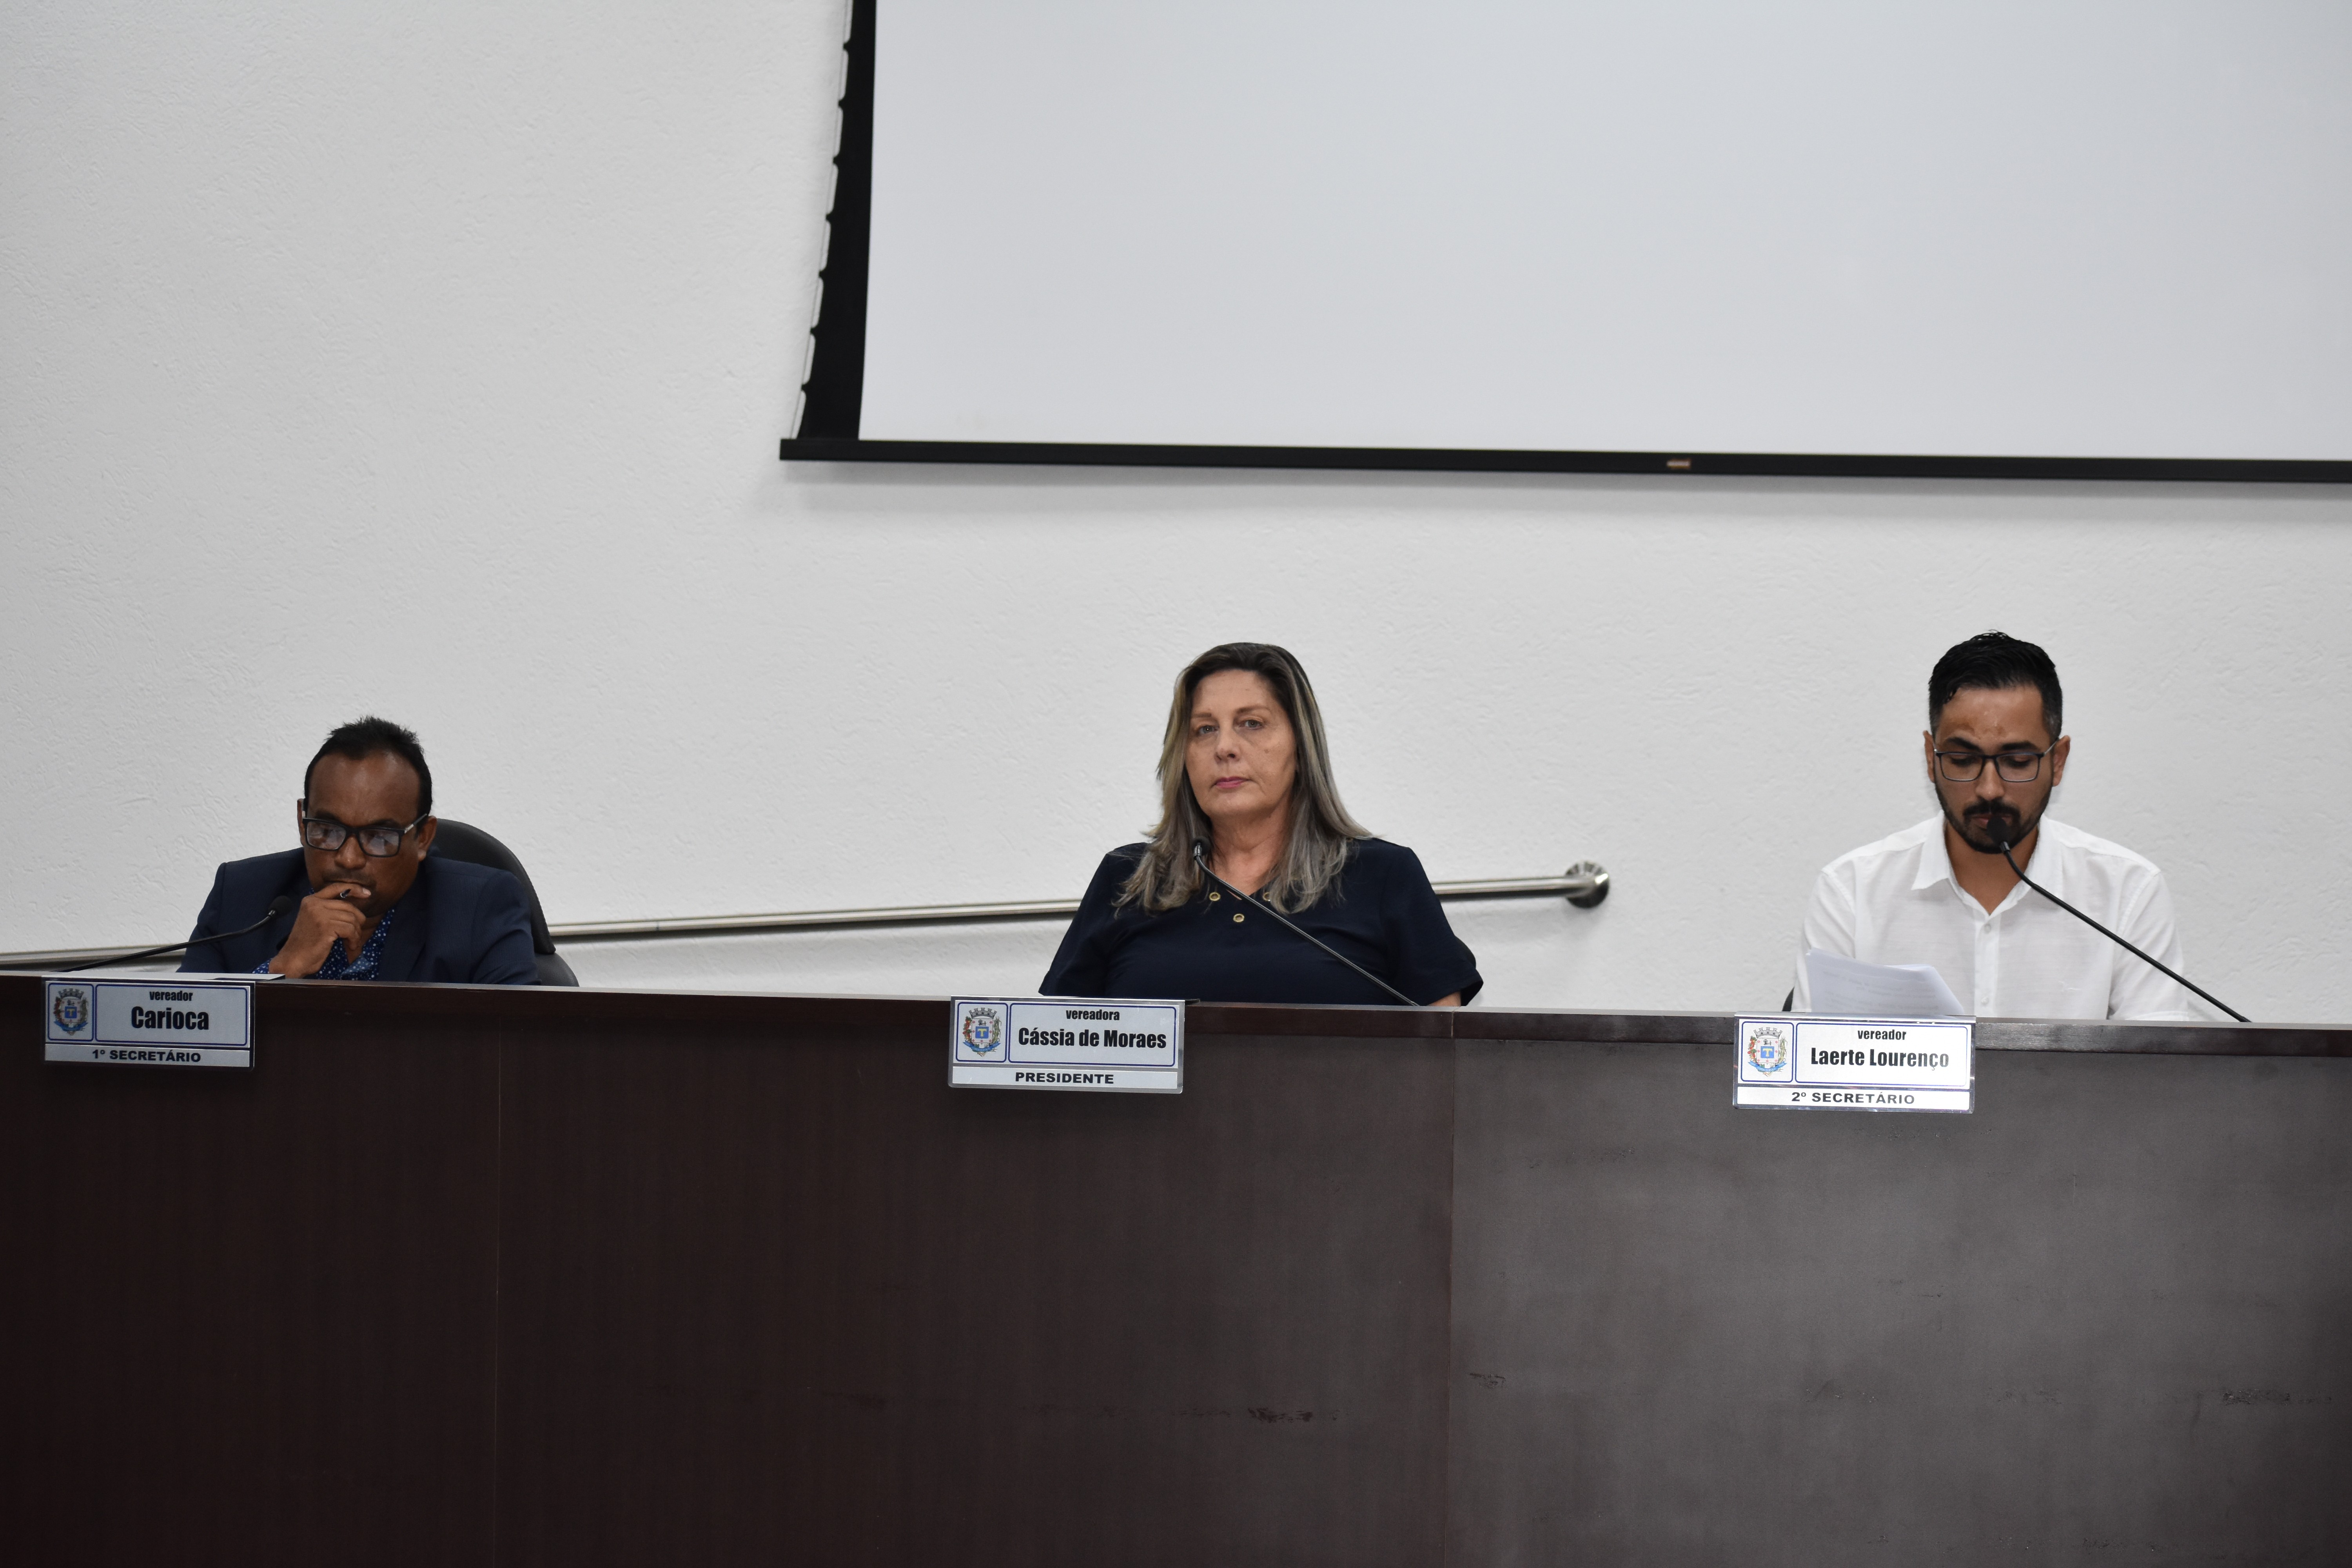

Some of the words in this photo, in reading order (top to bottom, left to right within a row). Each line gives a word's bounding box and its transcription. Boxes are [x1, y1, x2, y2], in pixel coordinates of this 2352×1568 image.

[149, 990, 193, 1002] vereador
[131, 1006, 209, 1030] Carioca
[1066, 1009, 1120, 1020] vereadora
[1019, 1027, 1074, 1046] Cássia
[1079, 1029, 1099, 1047] de
[1104, 1030, 1166, 1048] Moraes
[1858, 1029, 1906, 1040] vereador
[109, 1049, 201, 1063] SECRETÁRIO
[1811, 1048, 1864, 1065] Laerte
[1870, 1049, 1949, 1071] Lourenço
[1016, 1073, 1113, 1084] PRESIDENTE
[1811, 1091, 1915, 1104] SECRETÁRIO
